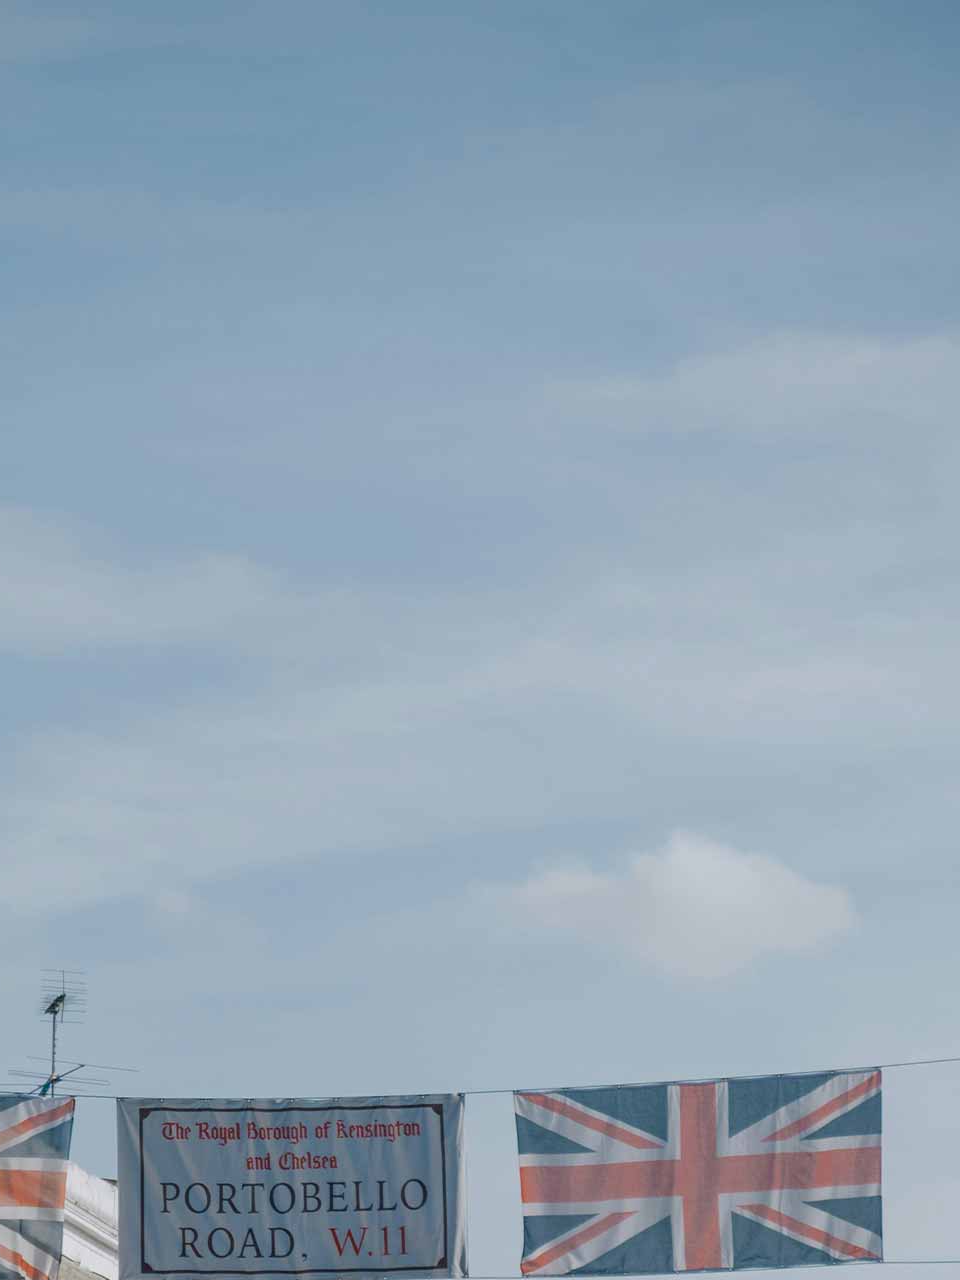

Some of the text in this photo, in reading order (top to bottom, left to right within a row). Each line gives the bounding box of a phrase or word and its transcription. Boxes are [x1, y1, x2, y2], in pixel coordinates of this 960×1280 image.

[162, 1120, 421, 1145] The Royal Borough of Kensington
[246, 1152, 338, 1170] and Chelsea
[160, 1178, 428, 1214] PORTOBELLO
[179, 1225, 408, 1261] ROAD, W.11
